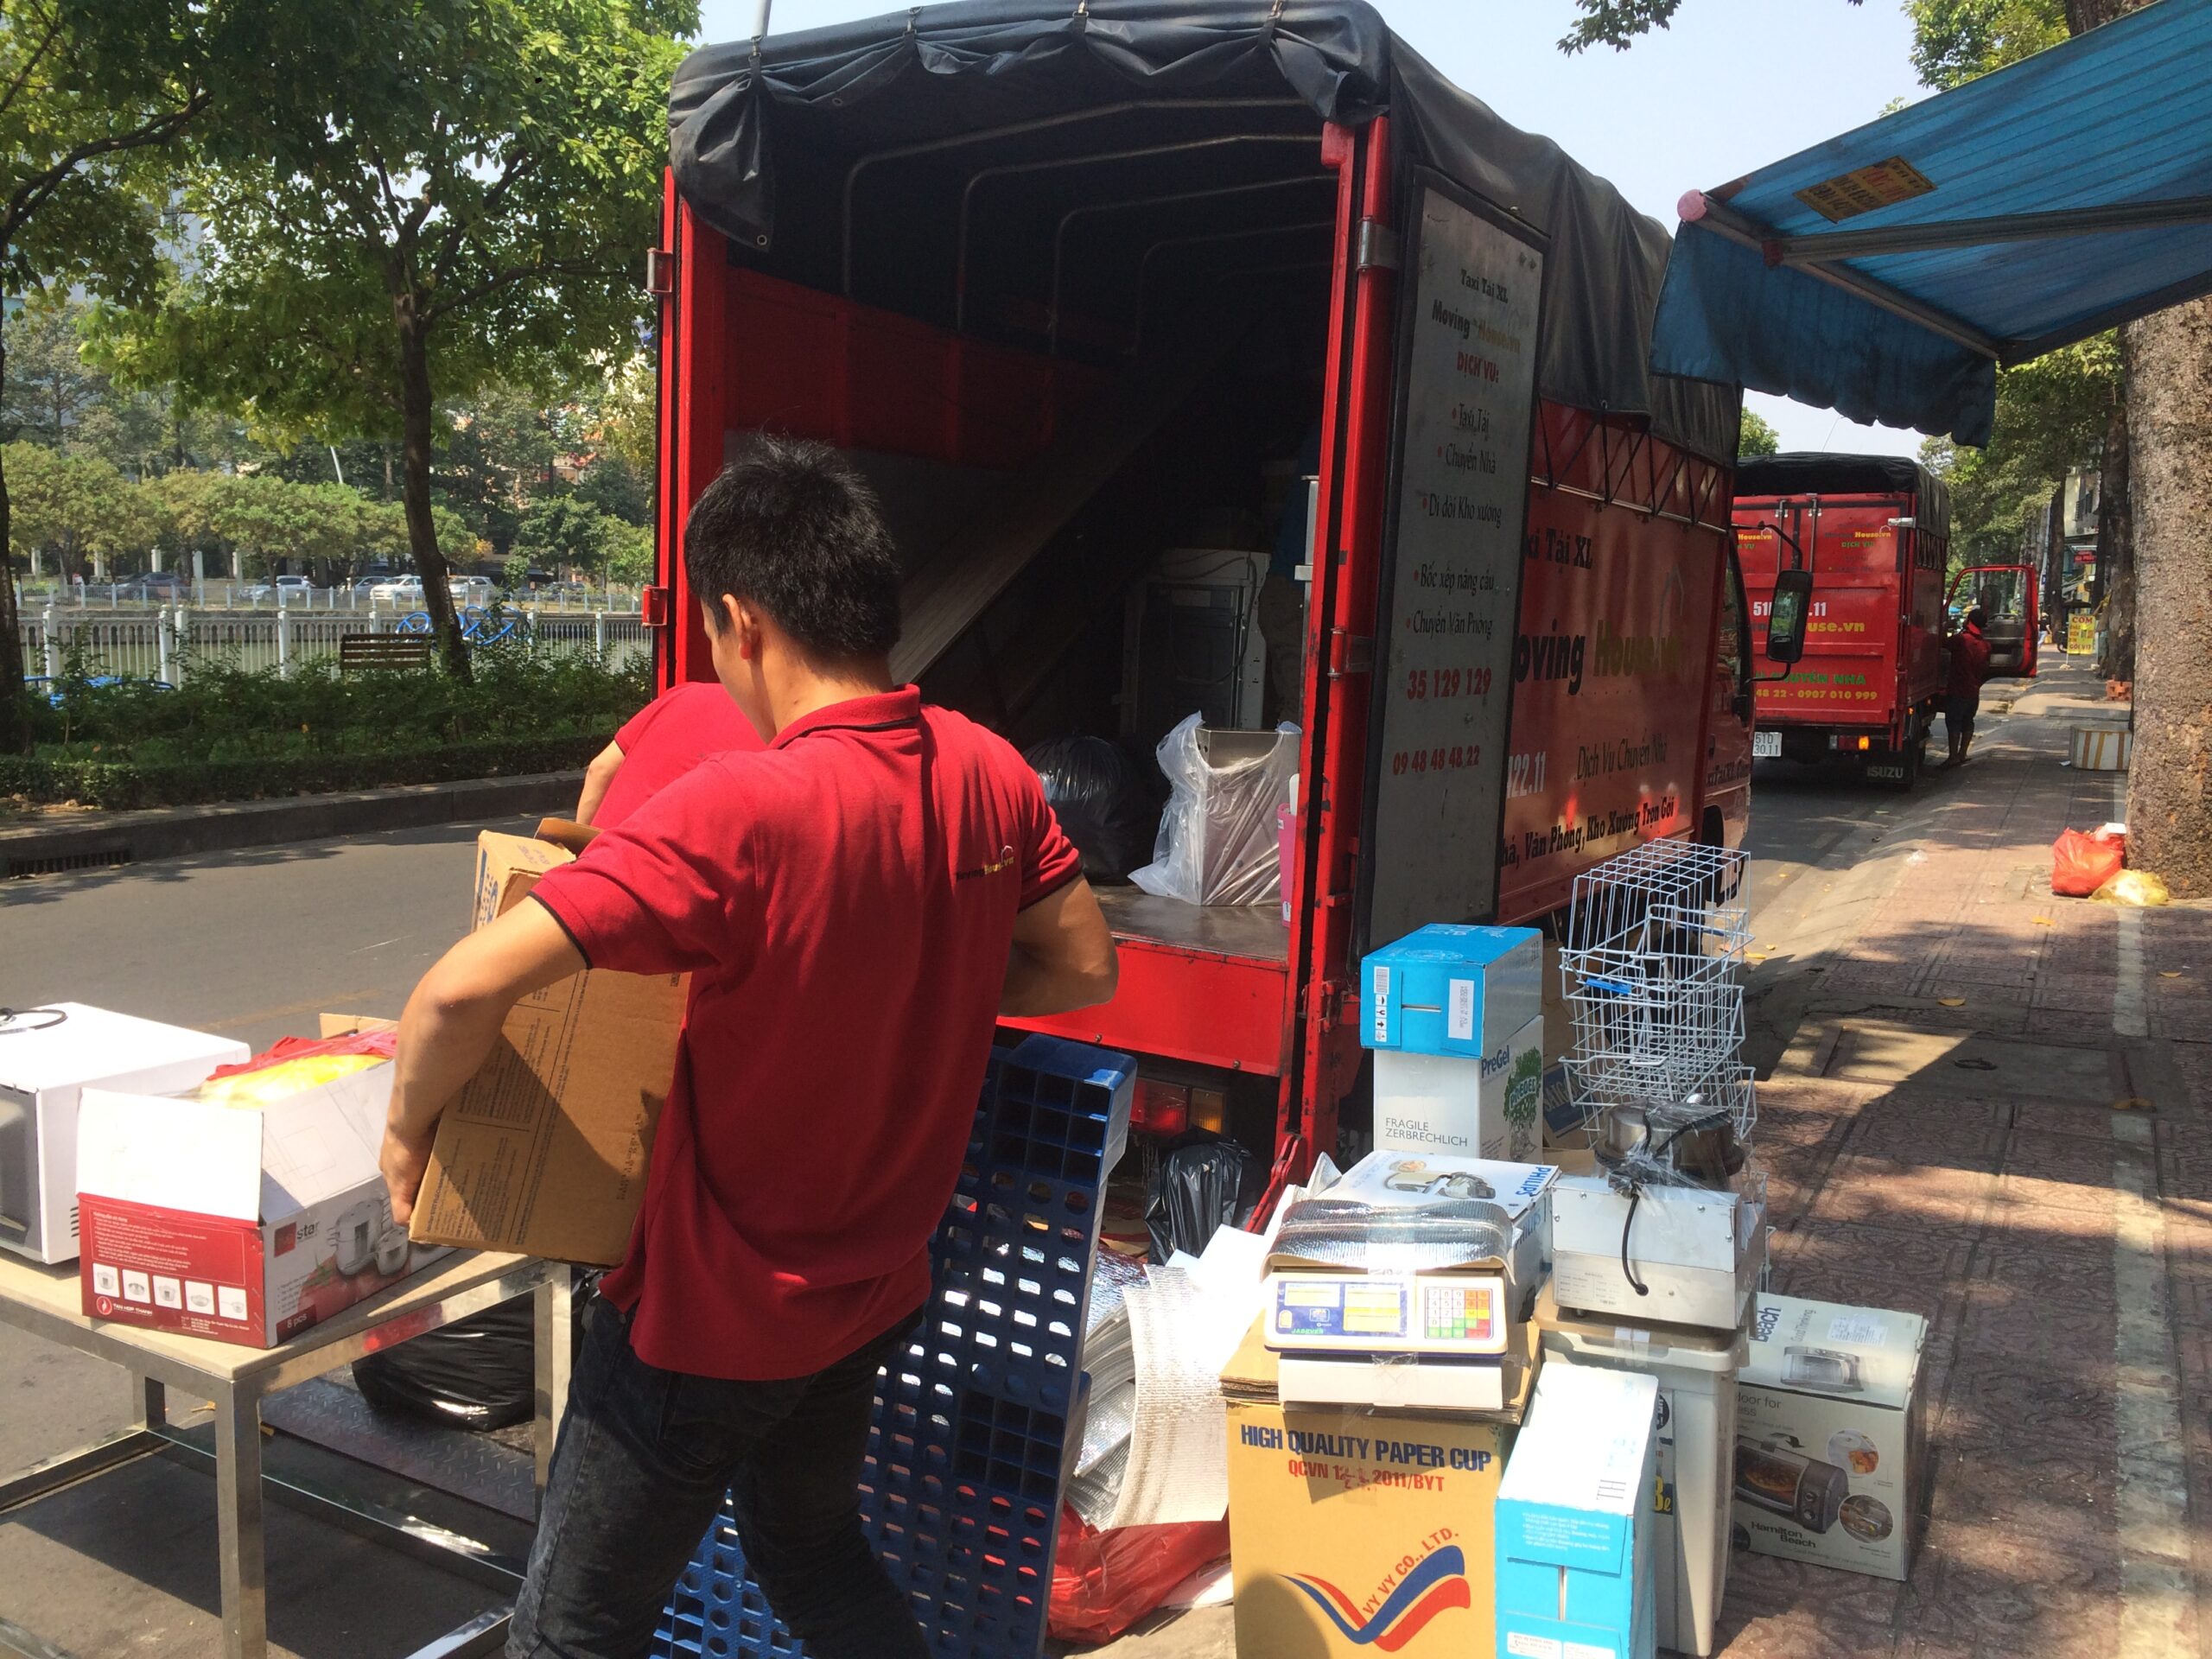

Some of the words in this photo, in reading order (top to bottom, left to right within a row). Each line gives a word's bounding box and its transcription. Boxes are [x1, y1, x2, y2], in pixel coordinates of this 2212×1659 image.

[1460, 269, 1479, 291] Taxi
[1496, 284, 1509, 304] XL
[1432, 299, 1471, 340] Moving
[1459, 404, 1475, 430] Taxi
[1458, 496, 1476, 520] Kho
[1573, 534, 1593, 570] XL
[1408, 670, 1427, 700] 35
[1433, 668, 1461, 698] 129
[1466, 666, 1492, 696] 129
[1772, 690, 1788, 699] 22
[1828, 691, 1853, 700] 010
[1854, 691, 1878, 701] 999
[1392, 753, 1408, 776] 09
[1410, 750, 1427, 773] 48
[1429, 748, 1446, 771] 48
[1448, 747, 1464, 768] 48
[1465, 745, 1480, 766] 22
[1866, 766, 1904, 779] ISUZU
[1586, 815, 1605, 842] Kho
[1481, 1045, 1510, 1078] PreGel
[1385, 1117, 1429, 1133] FRAGILE
[1385, 1128, 1468, 1147] ZERBRECHLICH
[1515, 1166, 1552, 1197] PHILIPS
[1764, 1395, 1782, 1409] for
[1241, 1424, 1283, 1450] HIGH
[1287, 1430, 1370, 1460] QUALITY
[1376, 1440, 1446, 1468] PAPER
[1449, 1447, 1491, 1472] CUP
[1288, 1459, 1329, 1478] QCVN
[1751, 1521, 1802, 1540] Hamilton
[1780, 1533, 1817, 1548] Beach
[1363, 1597, 1382, 1615] VY
[1377, 1574, 1397, 1595] VY
[1421, 1527, 1459, 1552] LTD.
